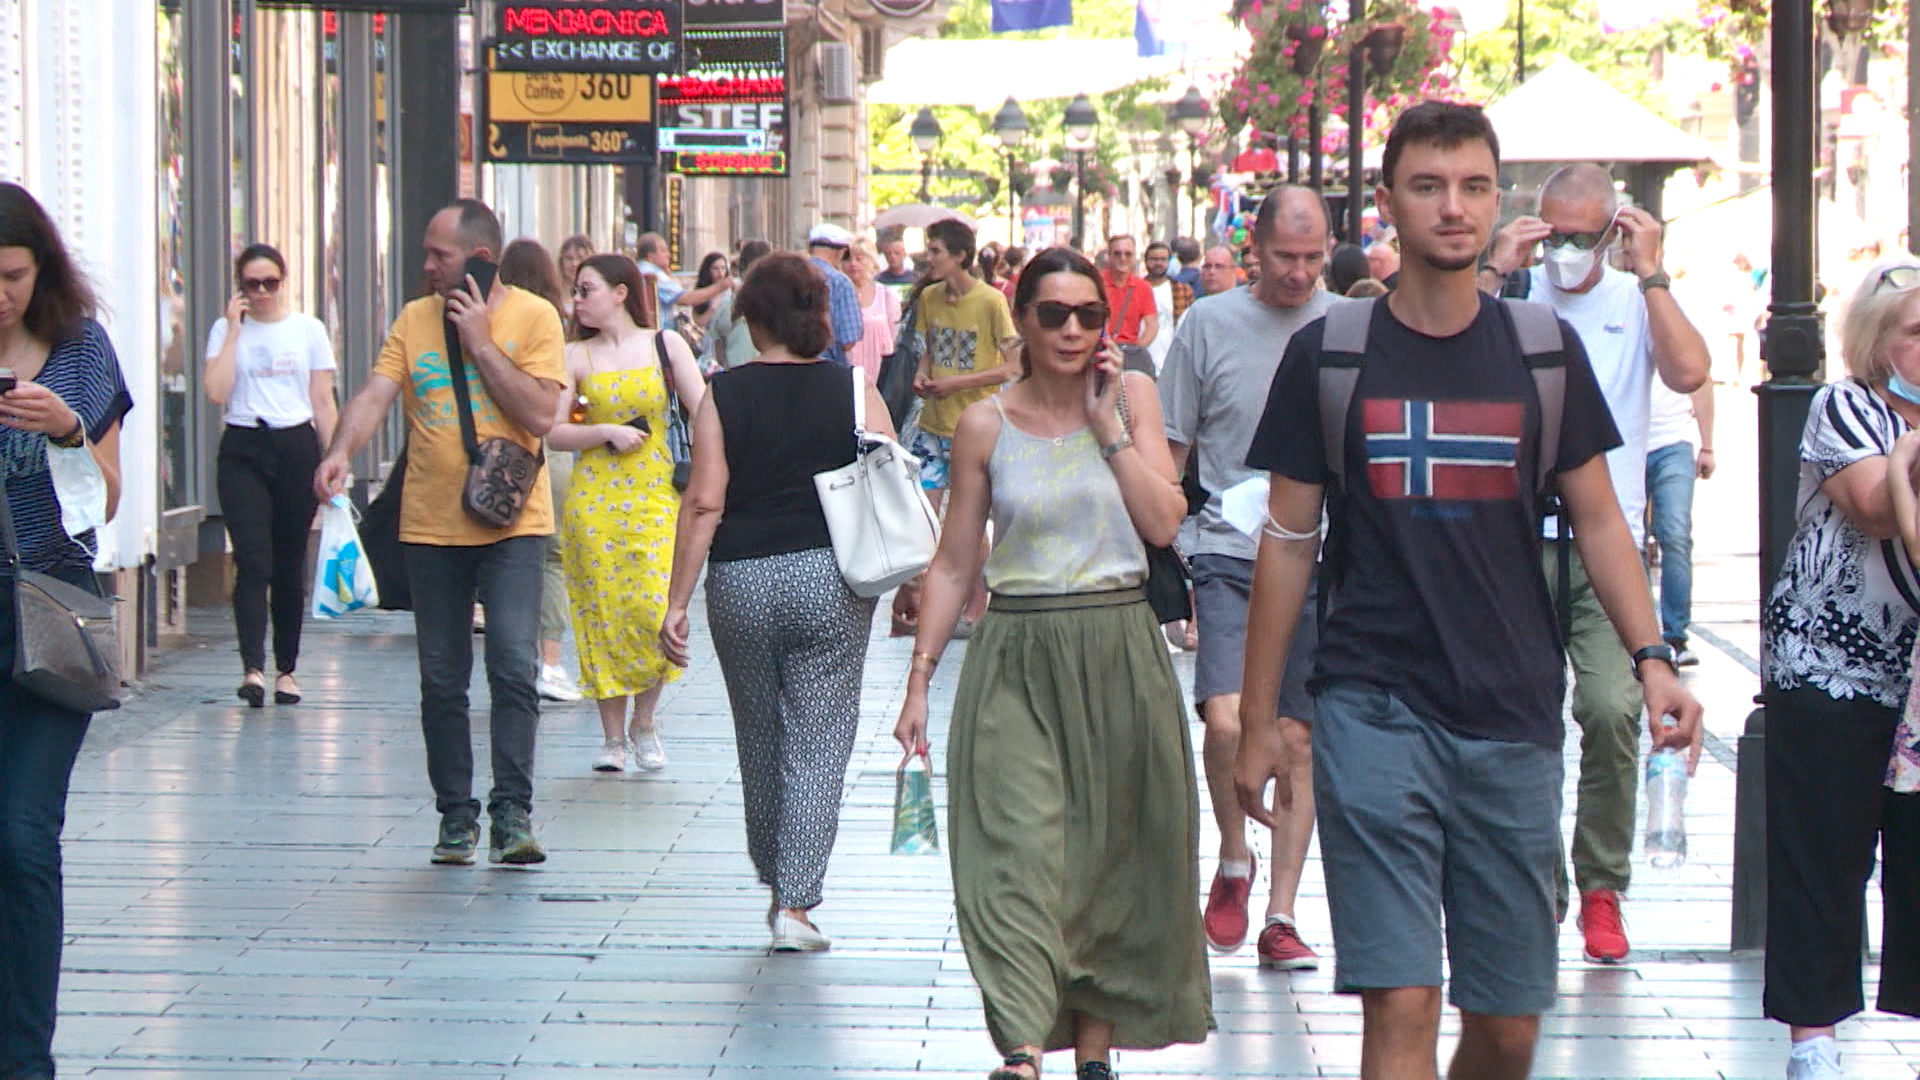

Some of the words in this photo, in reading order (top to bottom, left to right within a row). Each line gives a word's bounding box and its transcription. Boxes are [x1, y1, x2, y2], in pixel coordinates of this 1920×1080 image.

[531, 39, 641, 61] EXCHANGE
[525, 84, 565, 100] Coffee
[678, 103, 784, 129] STEF
